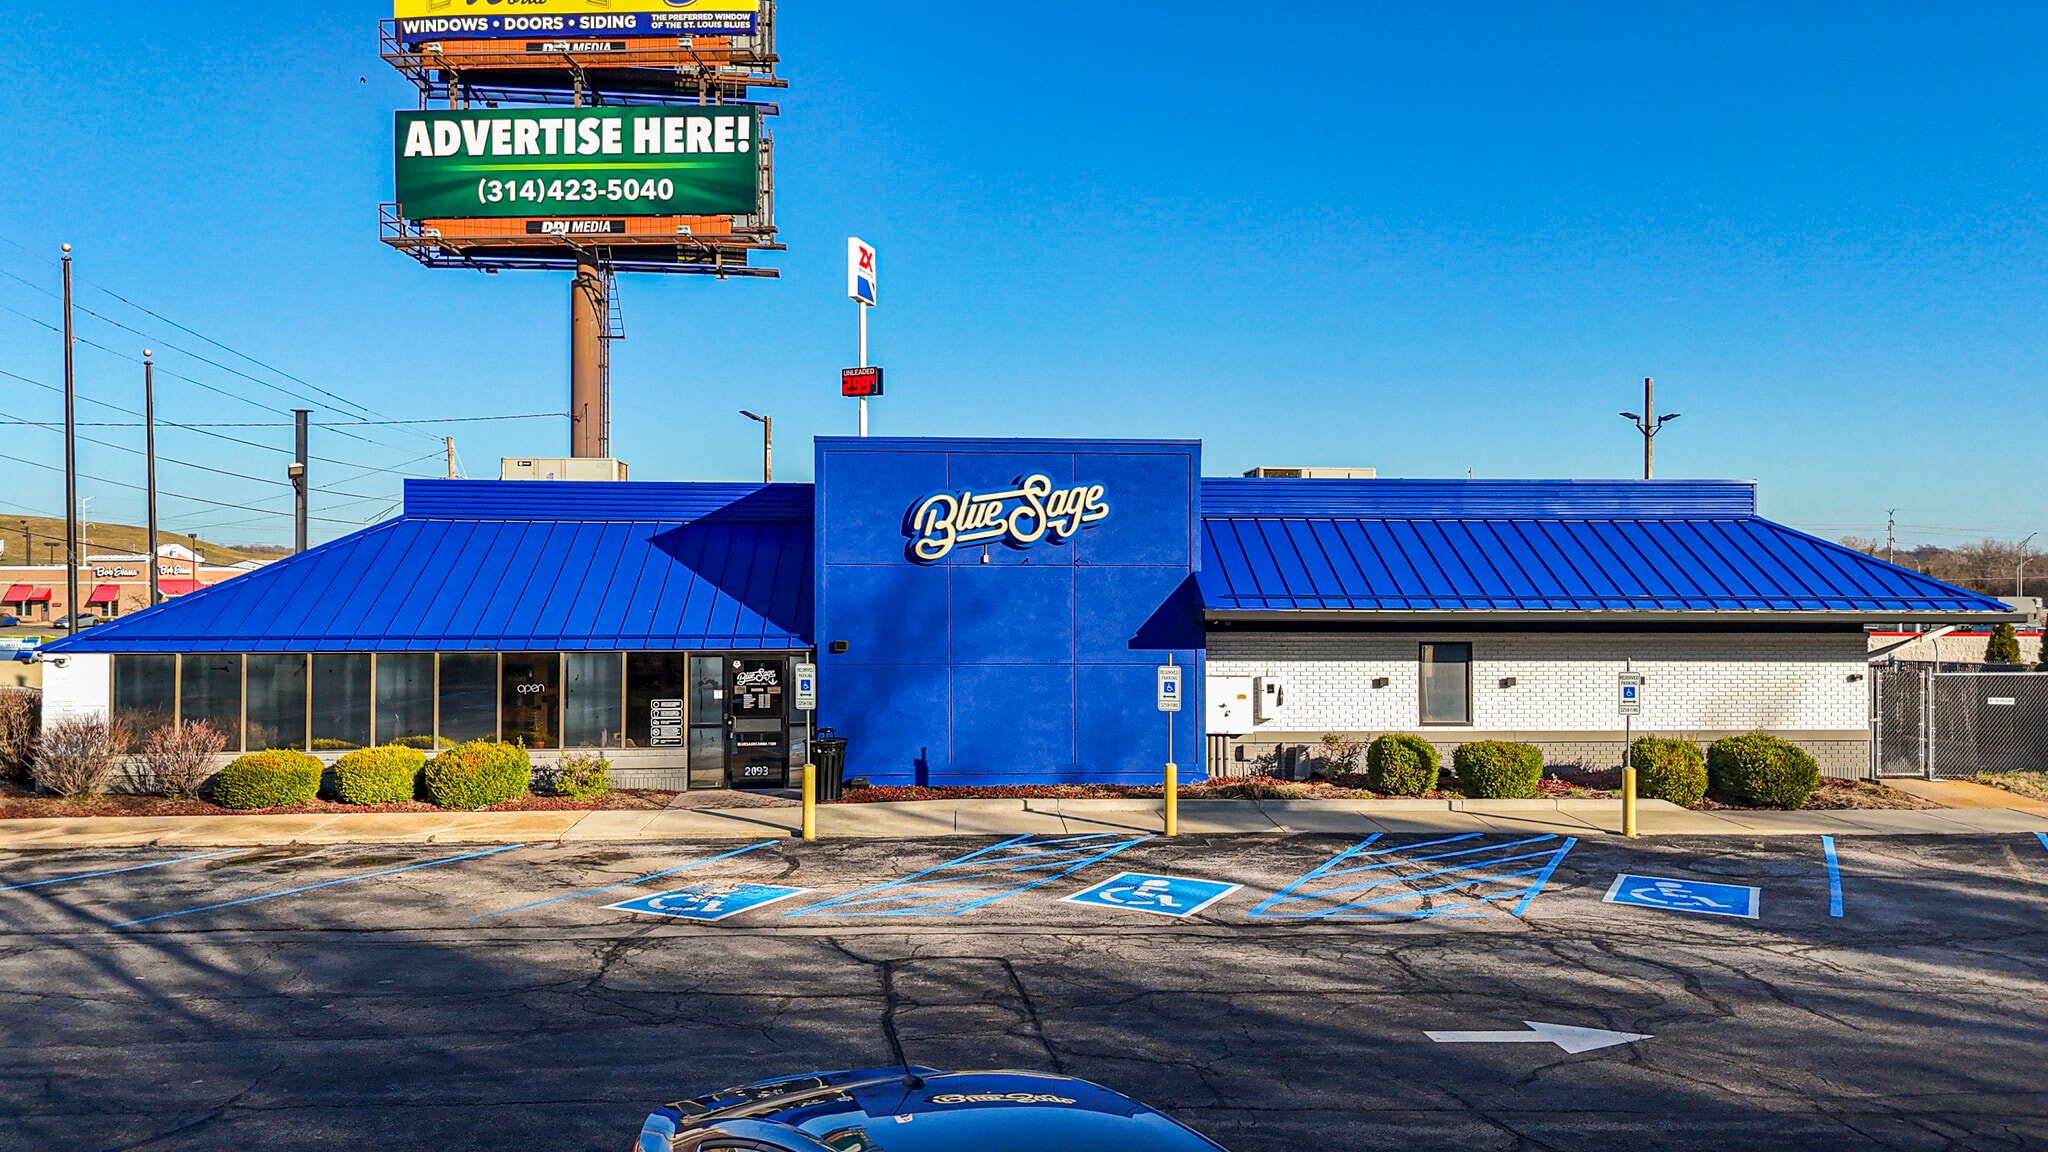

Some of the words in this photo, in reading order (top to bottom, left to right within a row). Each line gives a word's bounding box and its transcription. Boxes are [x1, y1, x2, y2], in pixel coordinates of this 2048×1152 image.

[668, 13, 713, 21] PREFERRED
[403, 17, 488, 34] WINDOWS
[504, 16, 564, 31] DOORS
[579, 15, 637, 29] SIDING
[573, 42, 611, 51] MEDIA
[403, 117, 623, 158] ADVERTISE
[634, 115, 751, 154] HERE!
[477, 178, 674, 205] (314)423-5040
[572, 220, 611, 232] MEDIA
[843, 368, 875, 377] UNLEADED
[914, 490, 1008, 560] Blue
[1006, 473, 1110, 543] Sage
[96, 566, 113, 577] Bob
[114, 566, 138, 577] Evans
[159, 564, 173, 575] Bob
[517, 683, 545, 695] open
[744, 766, 769, 776] 2093
